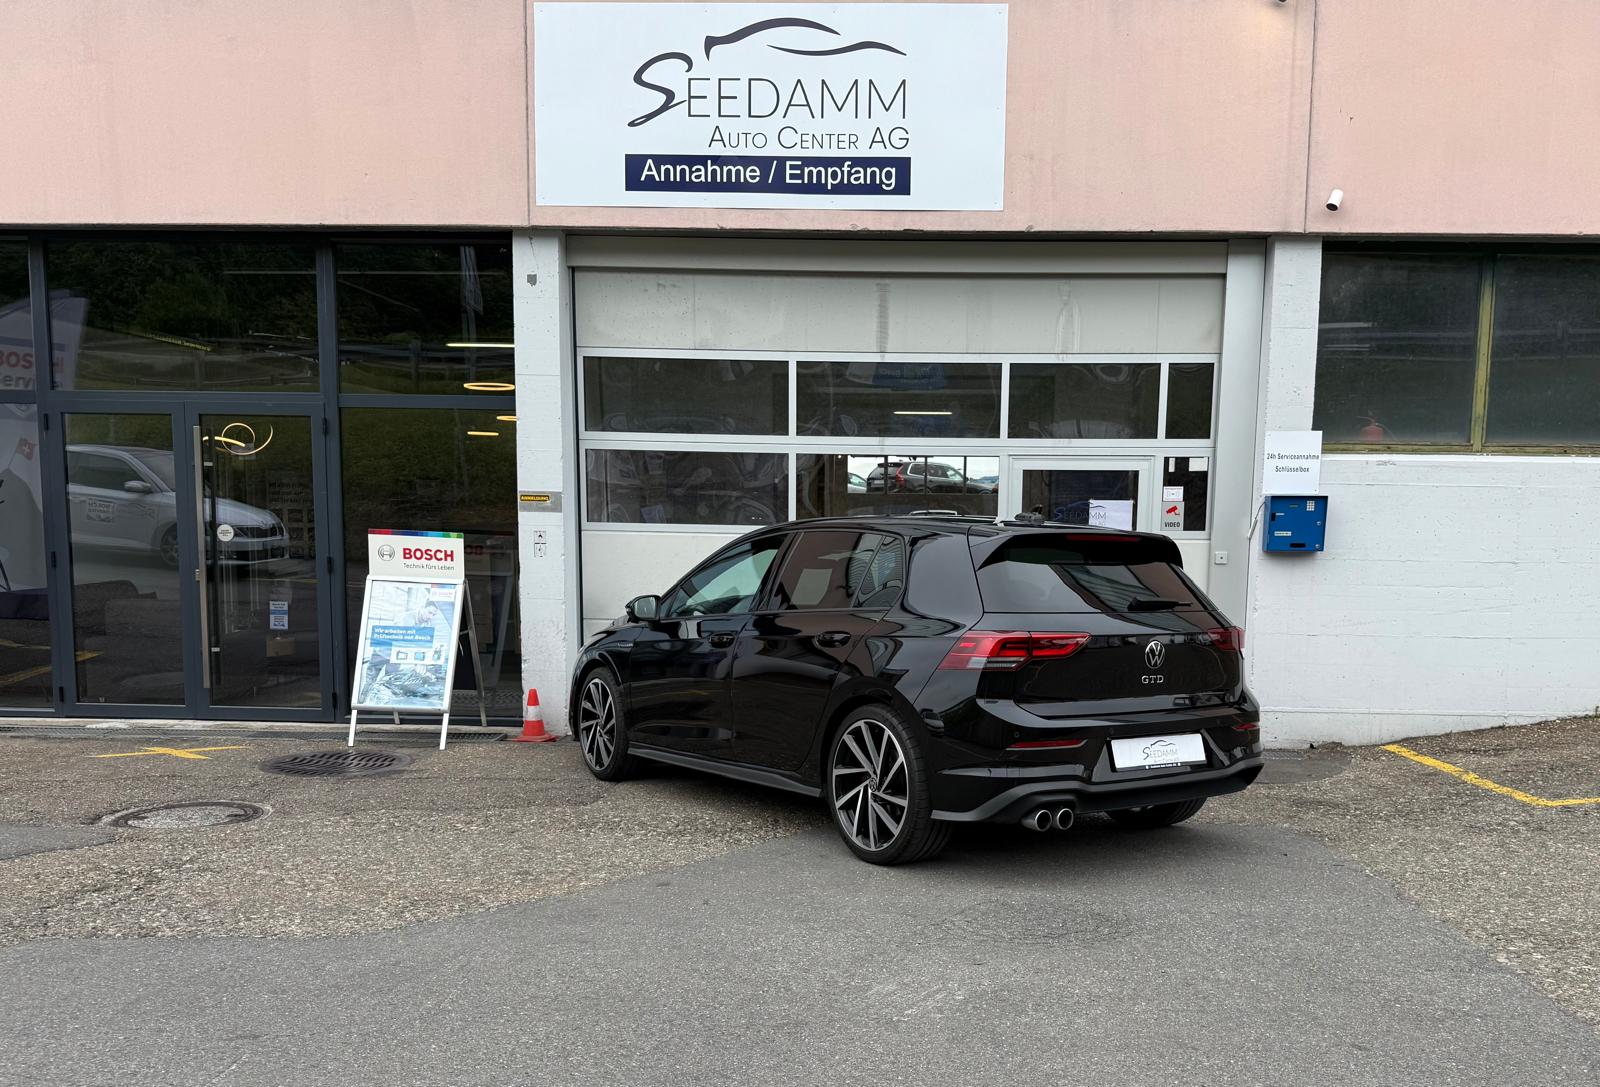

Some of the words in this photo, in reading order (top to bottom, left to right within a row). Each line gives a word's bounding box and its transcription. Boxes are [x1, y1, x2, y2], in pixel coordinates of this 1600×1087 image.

[627, 52, 907, 127] SEEDAMM
[869, 126, 909, 150] AG
[641, 159, 761, 183] Annahme
[768, 161, 776, 185] /
[785, 161, 897, 189] Empfang
[403, 548, 454, 562] BOSCH
[1141, 675, 1164, 684] GTD
